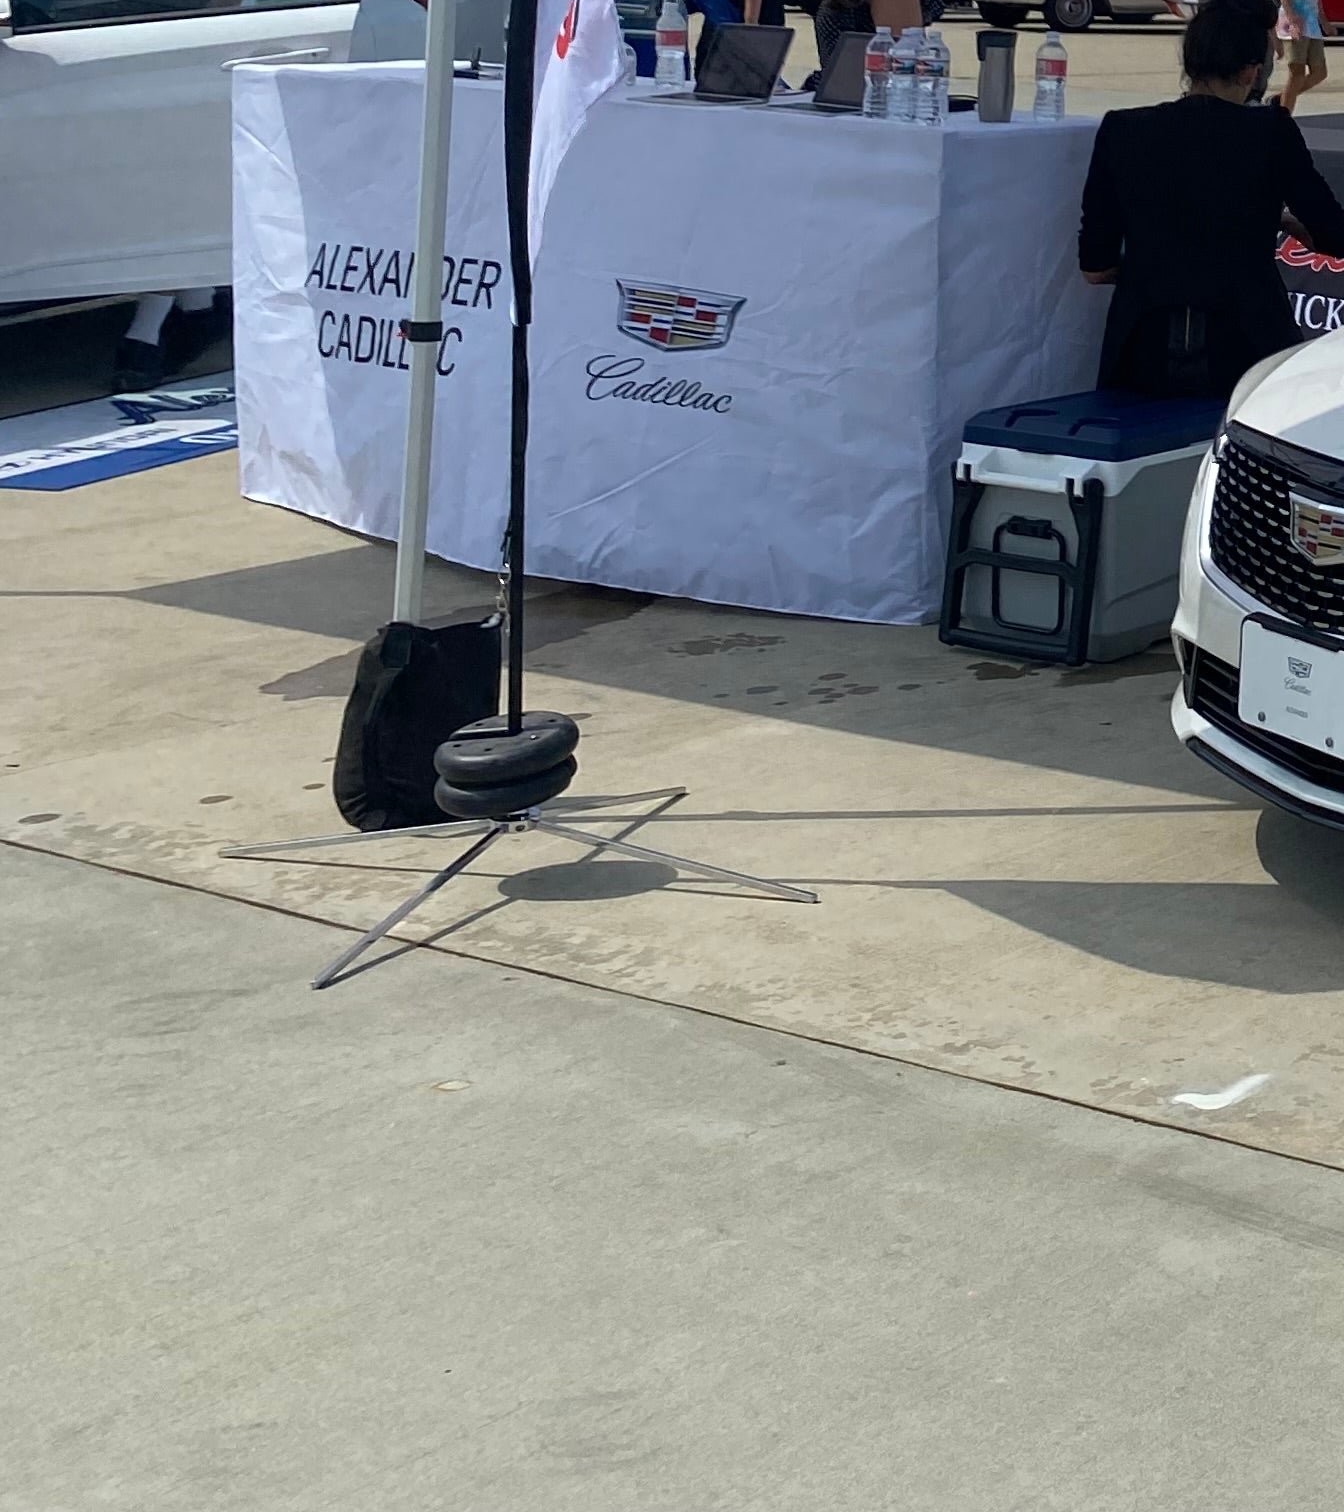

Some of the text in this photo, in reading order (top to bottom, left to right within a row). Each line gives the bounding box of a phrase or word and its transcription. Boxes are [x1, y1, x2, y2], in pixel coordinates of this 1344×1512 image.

[304, 243, 502, 309] ALEXADER
[318, 310, 463, 376] CADILLC
[586, 355, 732, 413] Cadillac
